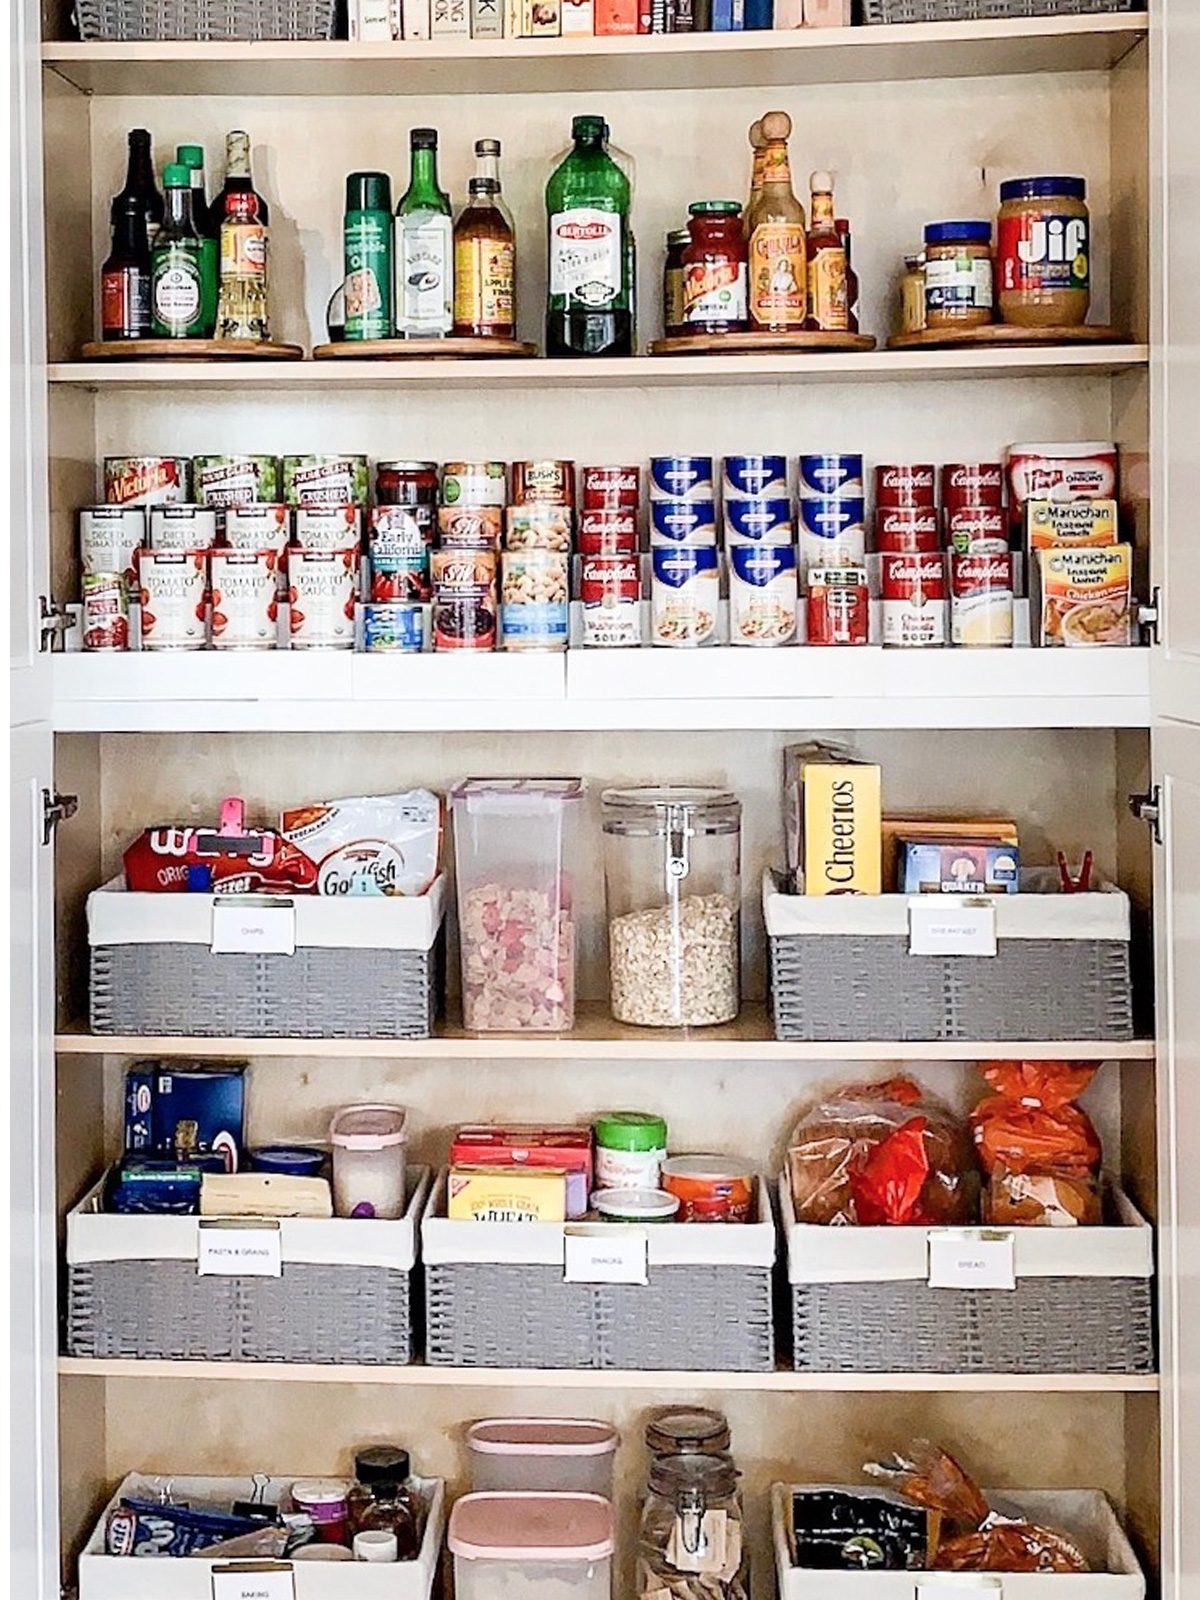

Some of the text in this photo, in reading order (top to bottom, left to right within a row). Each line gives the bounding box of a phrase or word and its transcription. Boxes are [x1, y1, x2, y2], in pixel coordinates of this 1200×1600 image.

[1018, 219, 1086, 262] Jif
[528, 470, 560, 481] BUSH'S
[883, 470, 933, 487] Campbell's
[951, 470, 1000, 487] Campbell's
[587, 475, 636, 492] Campbell's
[1048, 507, 1109, 519] Maruchan
[583, 517, 634, 534] Campbell's
[884, 516, 936, 533] Campbell's
[952, 515, 1002, 533] Campbell's
[230, 531, 276, 540] TOMATO
[301, 531, 345, 540] TOMATO
[382, 531, 413, 544] Early
[371, 543, 422, 555] California
[1062, 553, 1122, 564] Maruchan
[584, 564, 636, 582] Campbell's
[890, 561, 942, 580] Campbell's
[958, 561, 1009, 579] Campbell's
[148, 578, 194, 587] TOMATO
[219, 577, 266, 588] TOMATO
[296, 576, 342, 585] TOMATO
[1072, 575, 1104, 584] Lunch
[153, 588, 188, 598] SAUCE
[225, 588, 260, 598] SAUCE
[301, 587, 337, 596] SAUCE
[1066, 589, 1108, 599] Chicken
[588, 622, 633, 631] Mushroom
[594, 634, 627, 642] SOUP
[902, 633, 934, 641] SOUP
[825, 779, 855, 884] Cheerios
[941, 881, 985, 893] QUAKER
